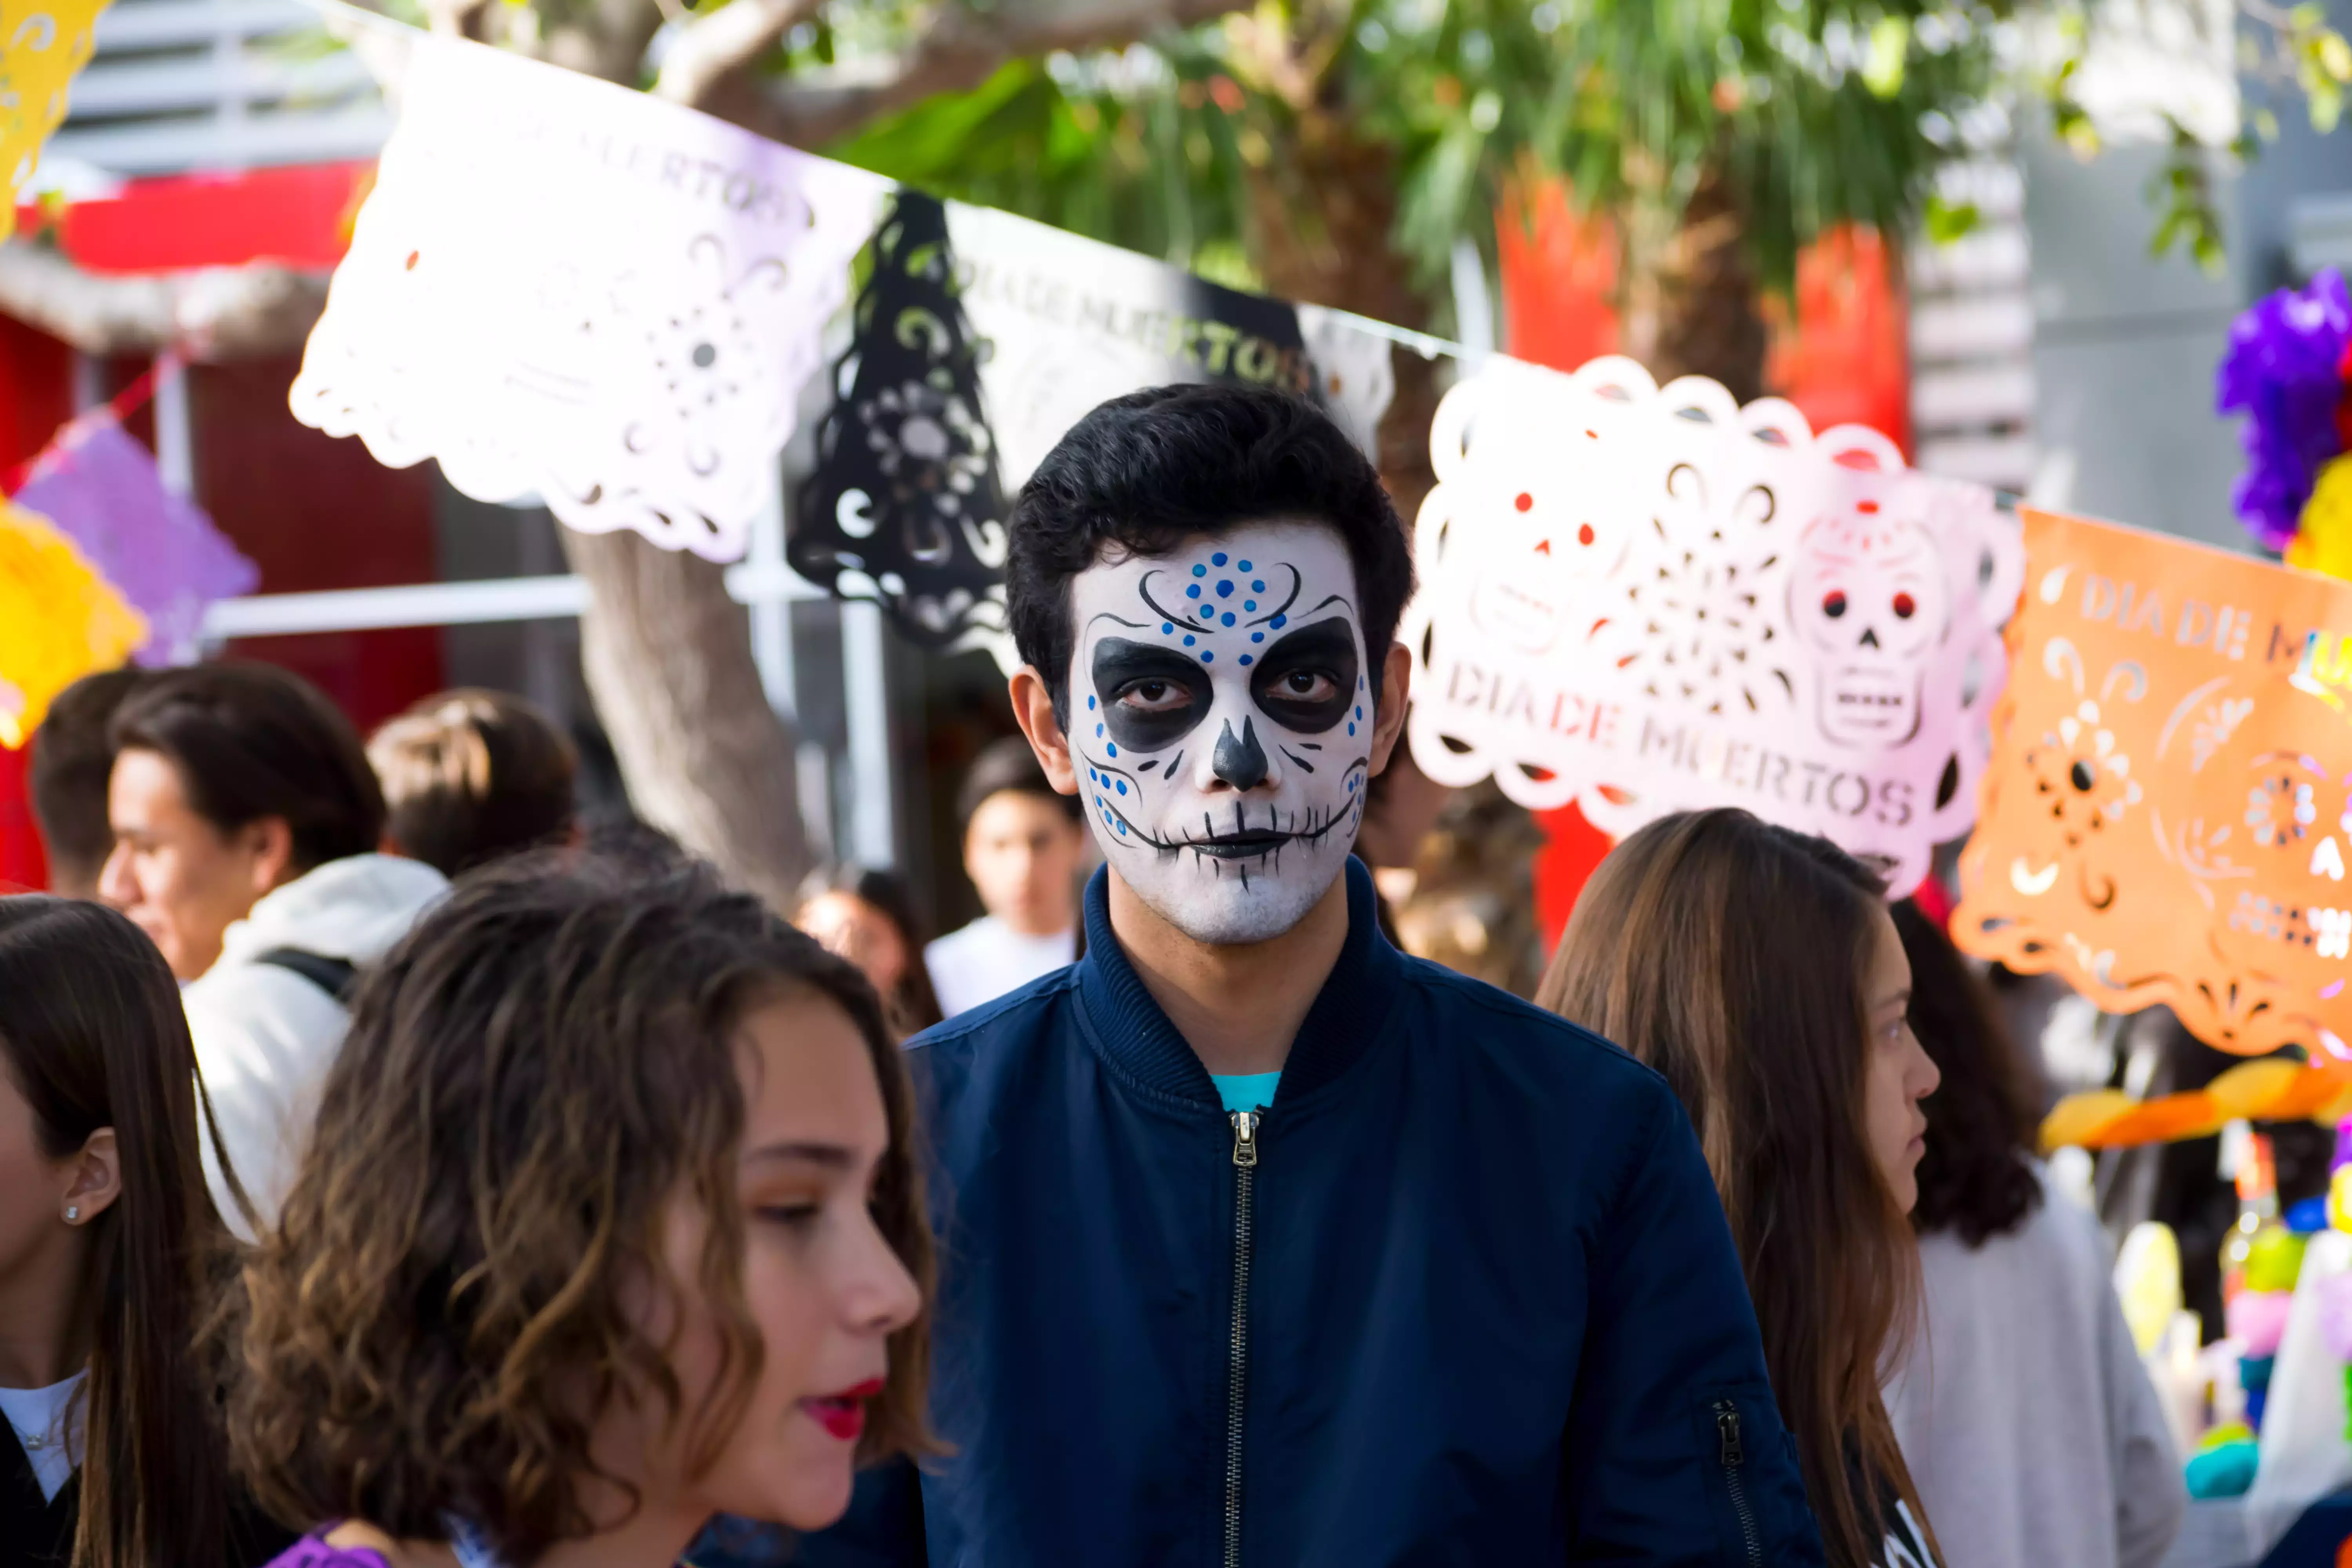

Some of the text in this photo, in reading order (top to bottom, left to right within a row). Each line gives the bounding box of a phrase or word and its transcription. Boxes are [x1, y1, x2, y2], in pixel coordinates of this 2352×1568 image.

[2082, 574, 2164, 637] DIA
[2176, 599, 2251, 661] DE
[1447, 661, 1915, 828] DIA DE MUERTOS
